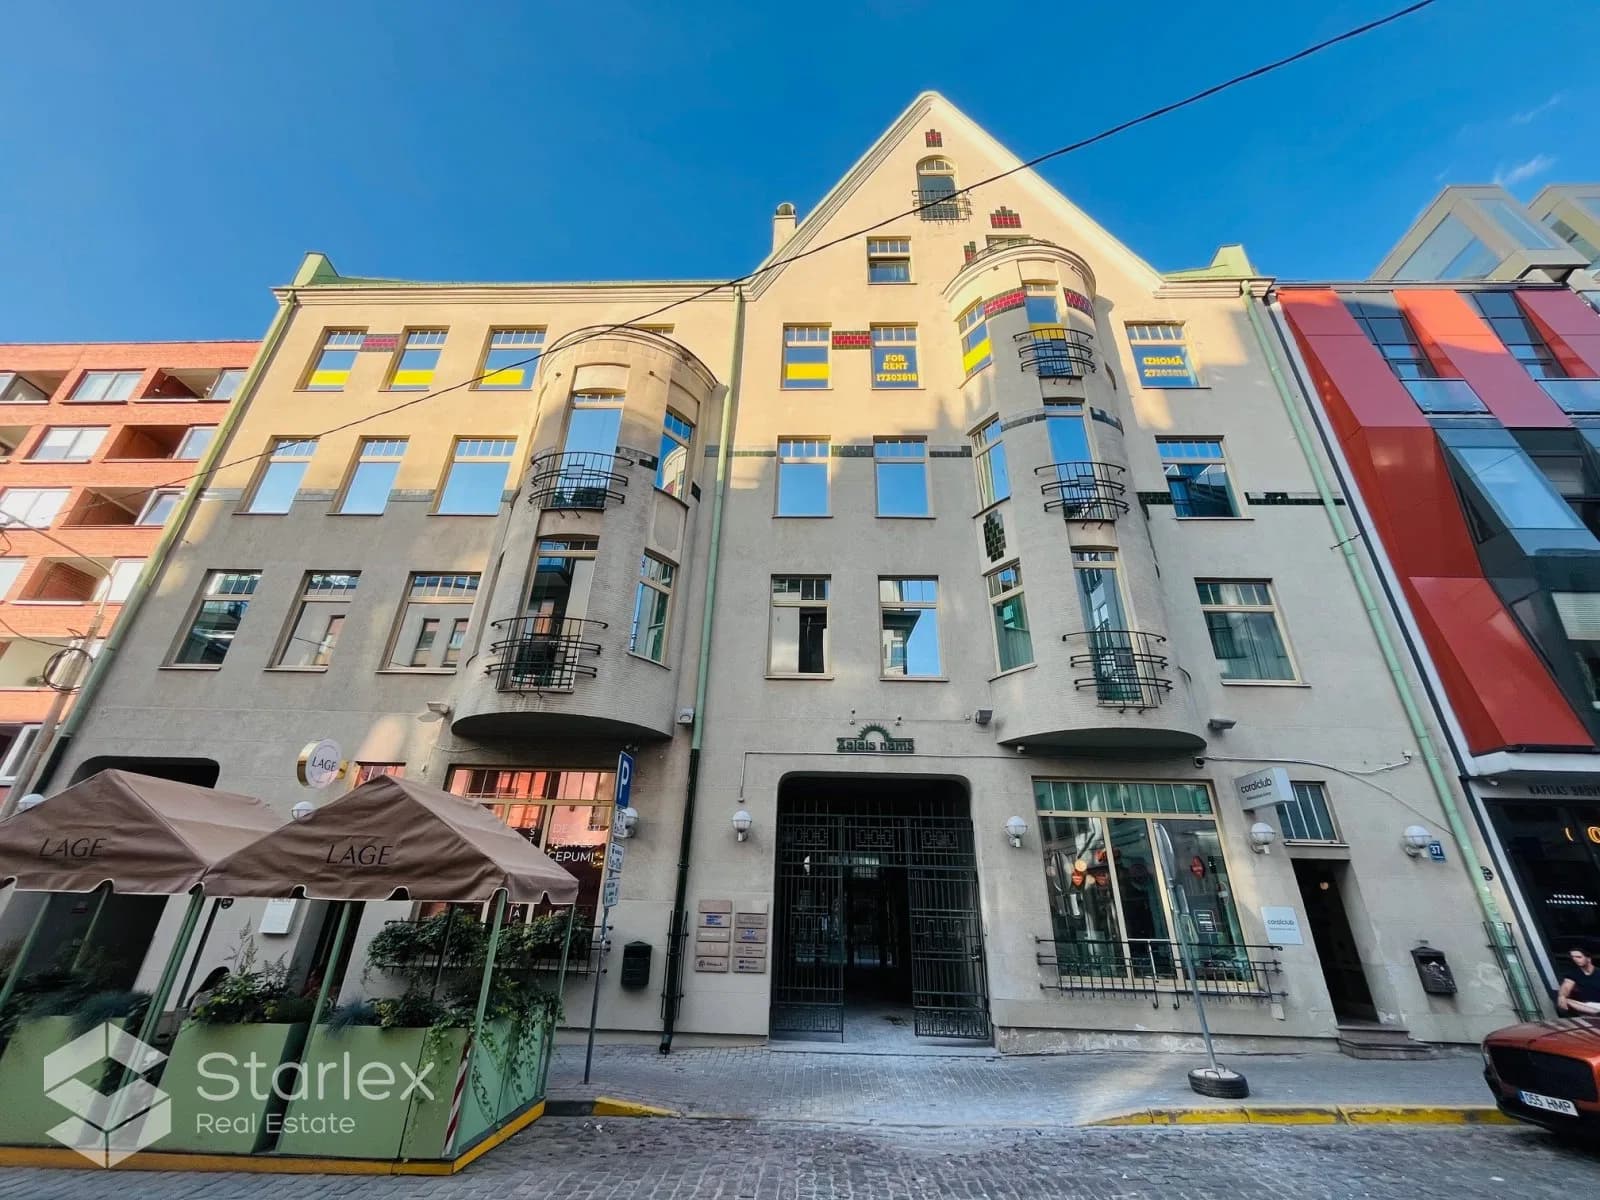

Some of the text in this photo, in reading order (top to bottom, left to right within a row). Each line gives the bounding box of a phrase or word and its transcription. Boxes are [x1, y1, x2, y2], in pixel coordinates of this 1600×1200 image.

[882, 362, 909, 370] RENT
[885, 354, 905, 362] FOR
[311, 756, 337, 772] LAGE
[619, 760, 630, 801] P
[1240, 776, 1273, 794] coralclub
[39, 837, 108, 858] LAGE
[325, 844, 394, 866] LAGE
[1430, 845, 1441, 855] 37
[547, 850, 595, 863] CEPUMI
